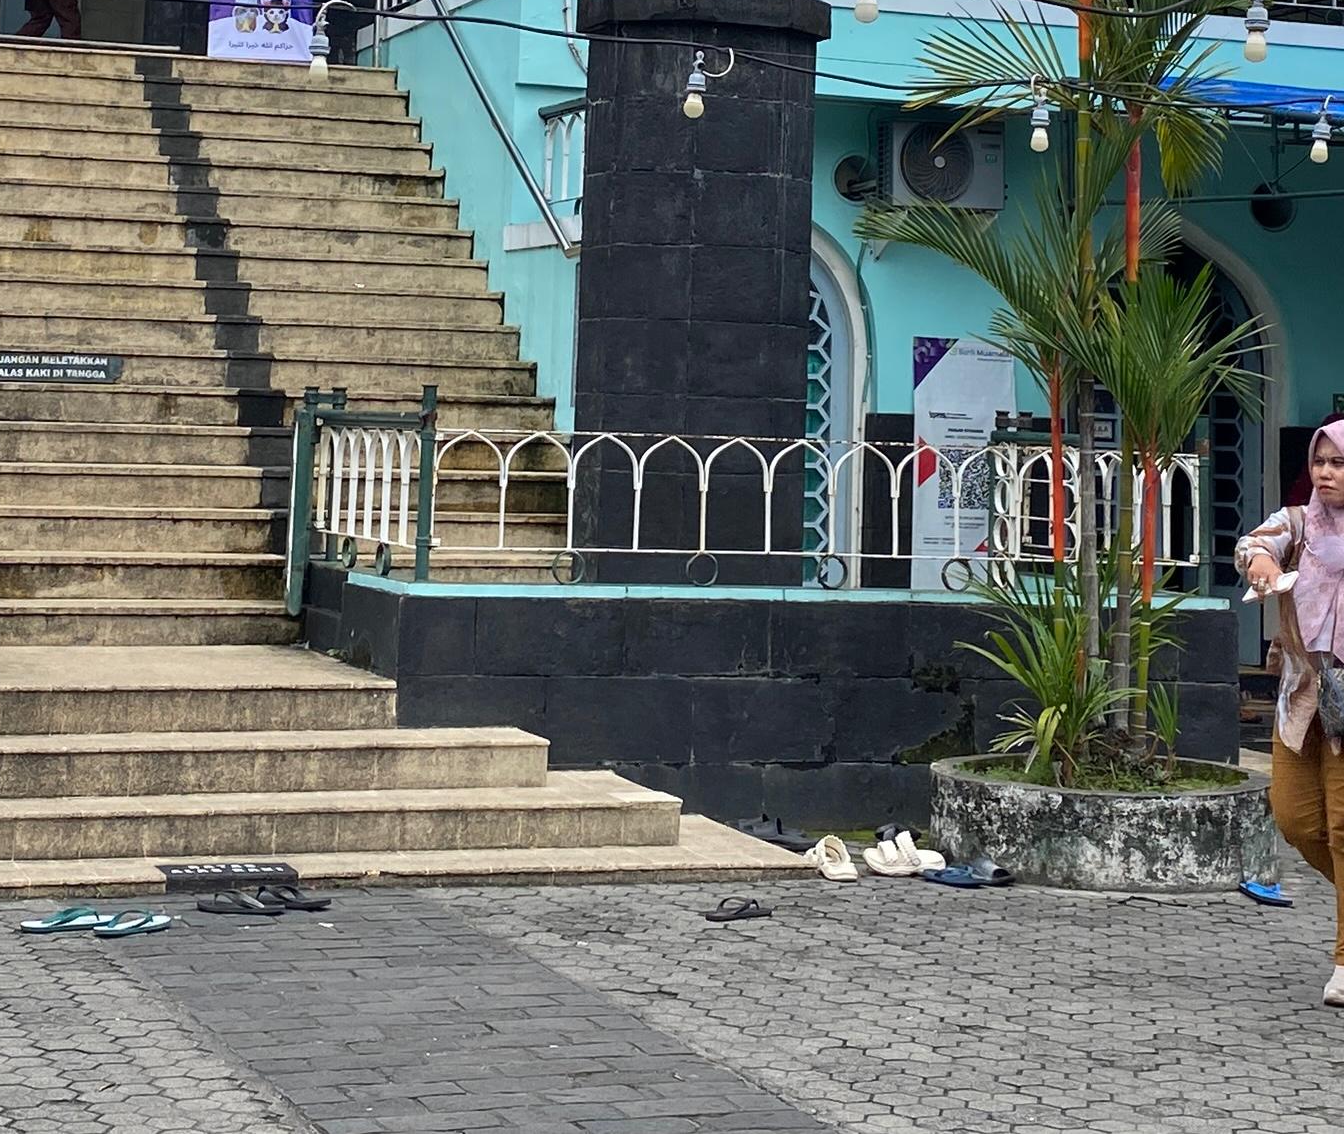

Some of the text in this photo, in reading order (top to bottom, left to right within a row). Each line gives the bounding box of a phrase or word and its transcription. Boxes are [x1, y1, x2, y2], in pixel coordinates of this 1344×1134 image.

[41, 356, 108, 366] MELETAKKAN
[25, 369, 51, 377] KAKI
[53, 369, 63, 377] DI
[66, 370, 106, 379] TANGGA
